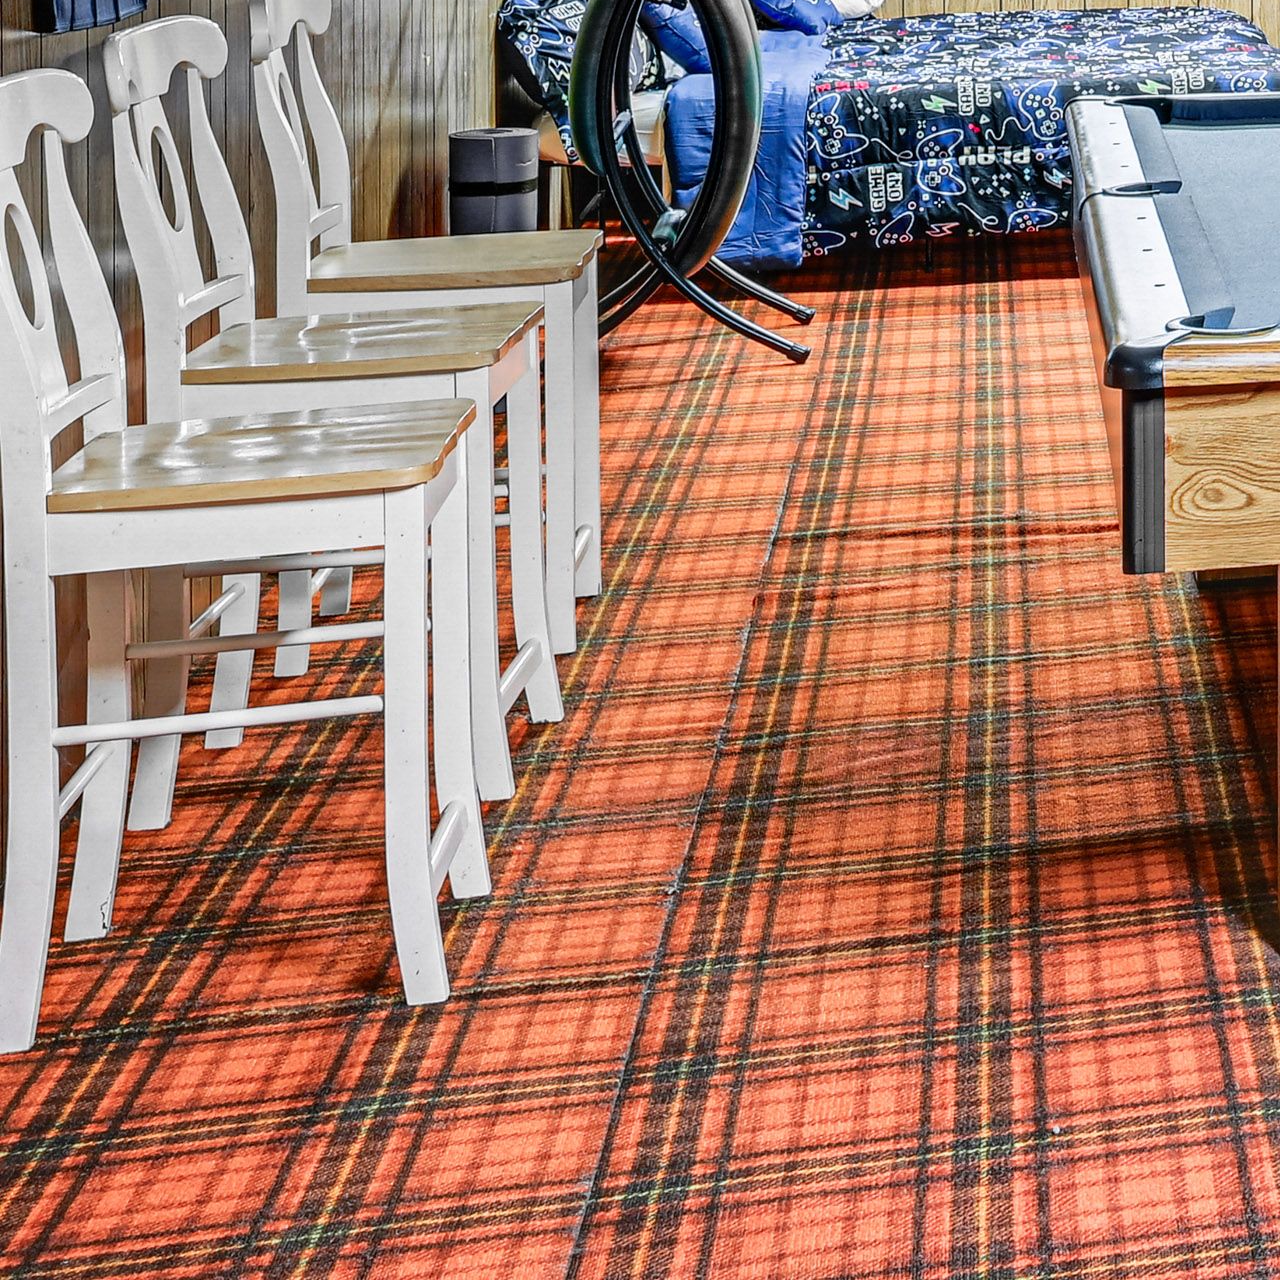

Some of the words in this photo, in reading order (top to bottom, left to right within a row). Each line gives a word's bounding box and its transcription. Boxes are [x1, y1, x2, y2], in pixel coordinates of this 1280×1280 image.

[549, 0, 586, 19] GAME
[958, 146, 1031, 166] PLAY
[868, 166, 886, 212] GAME
[886, 172, 904, 202] ON
